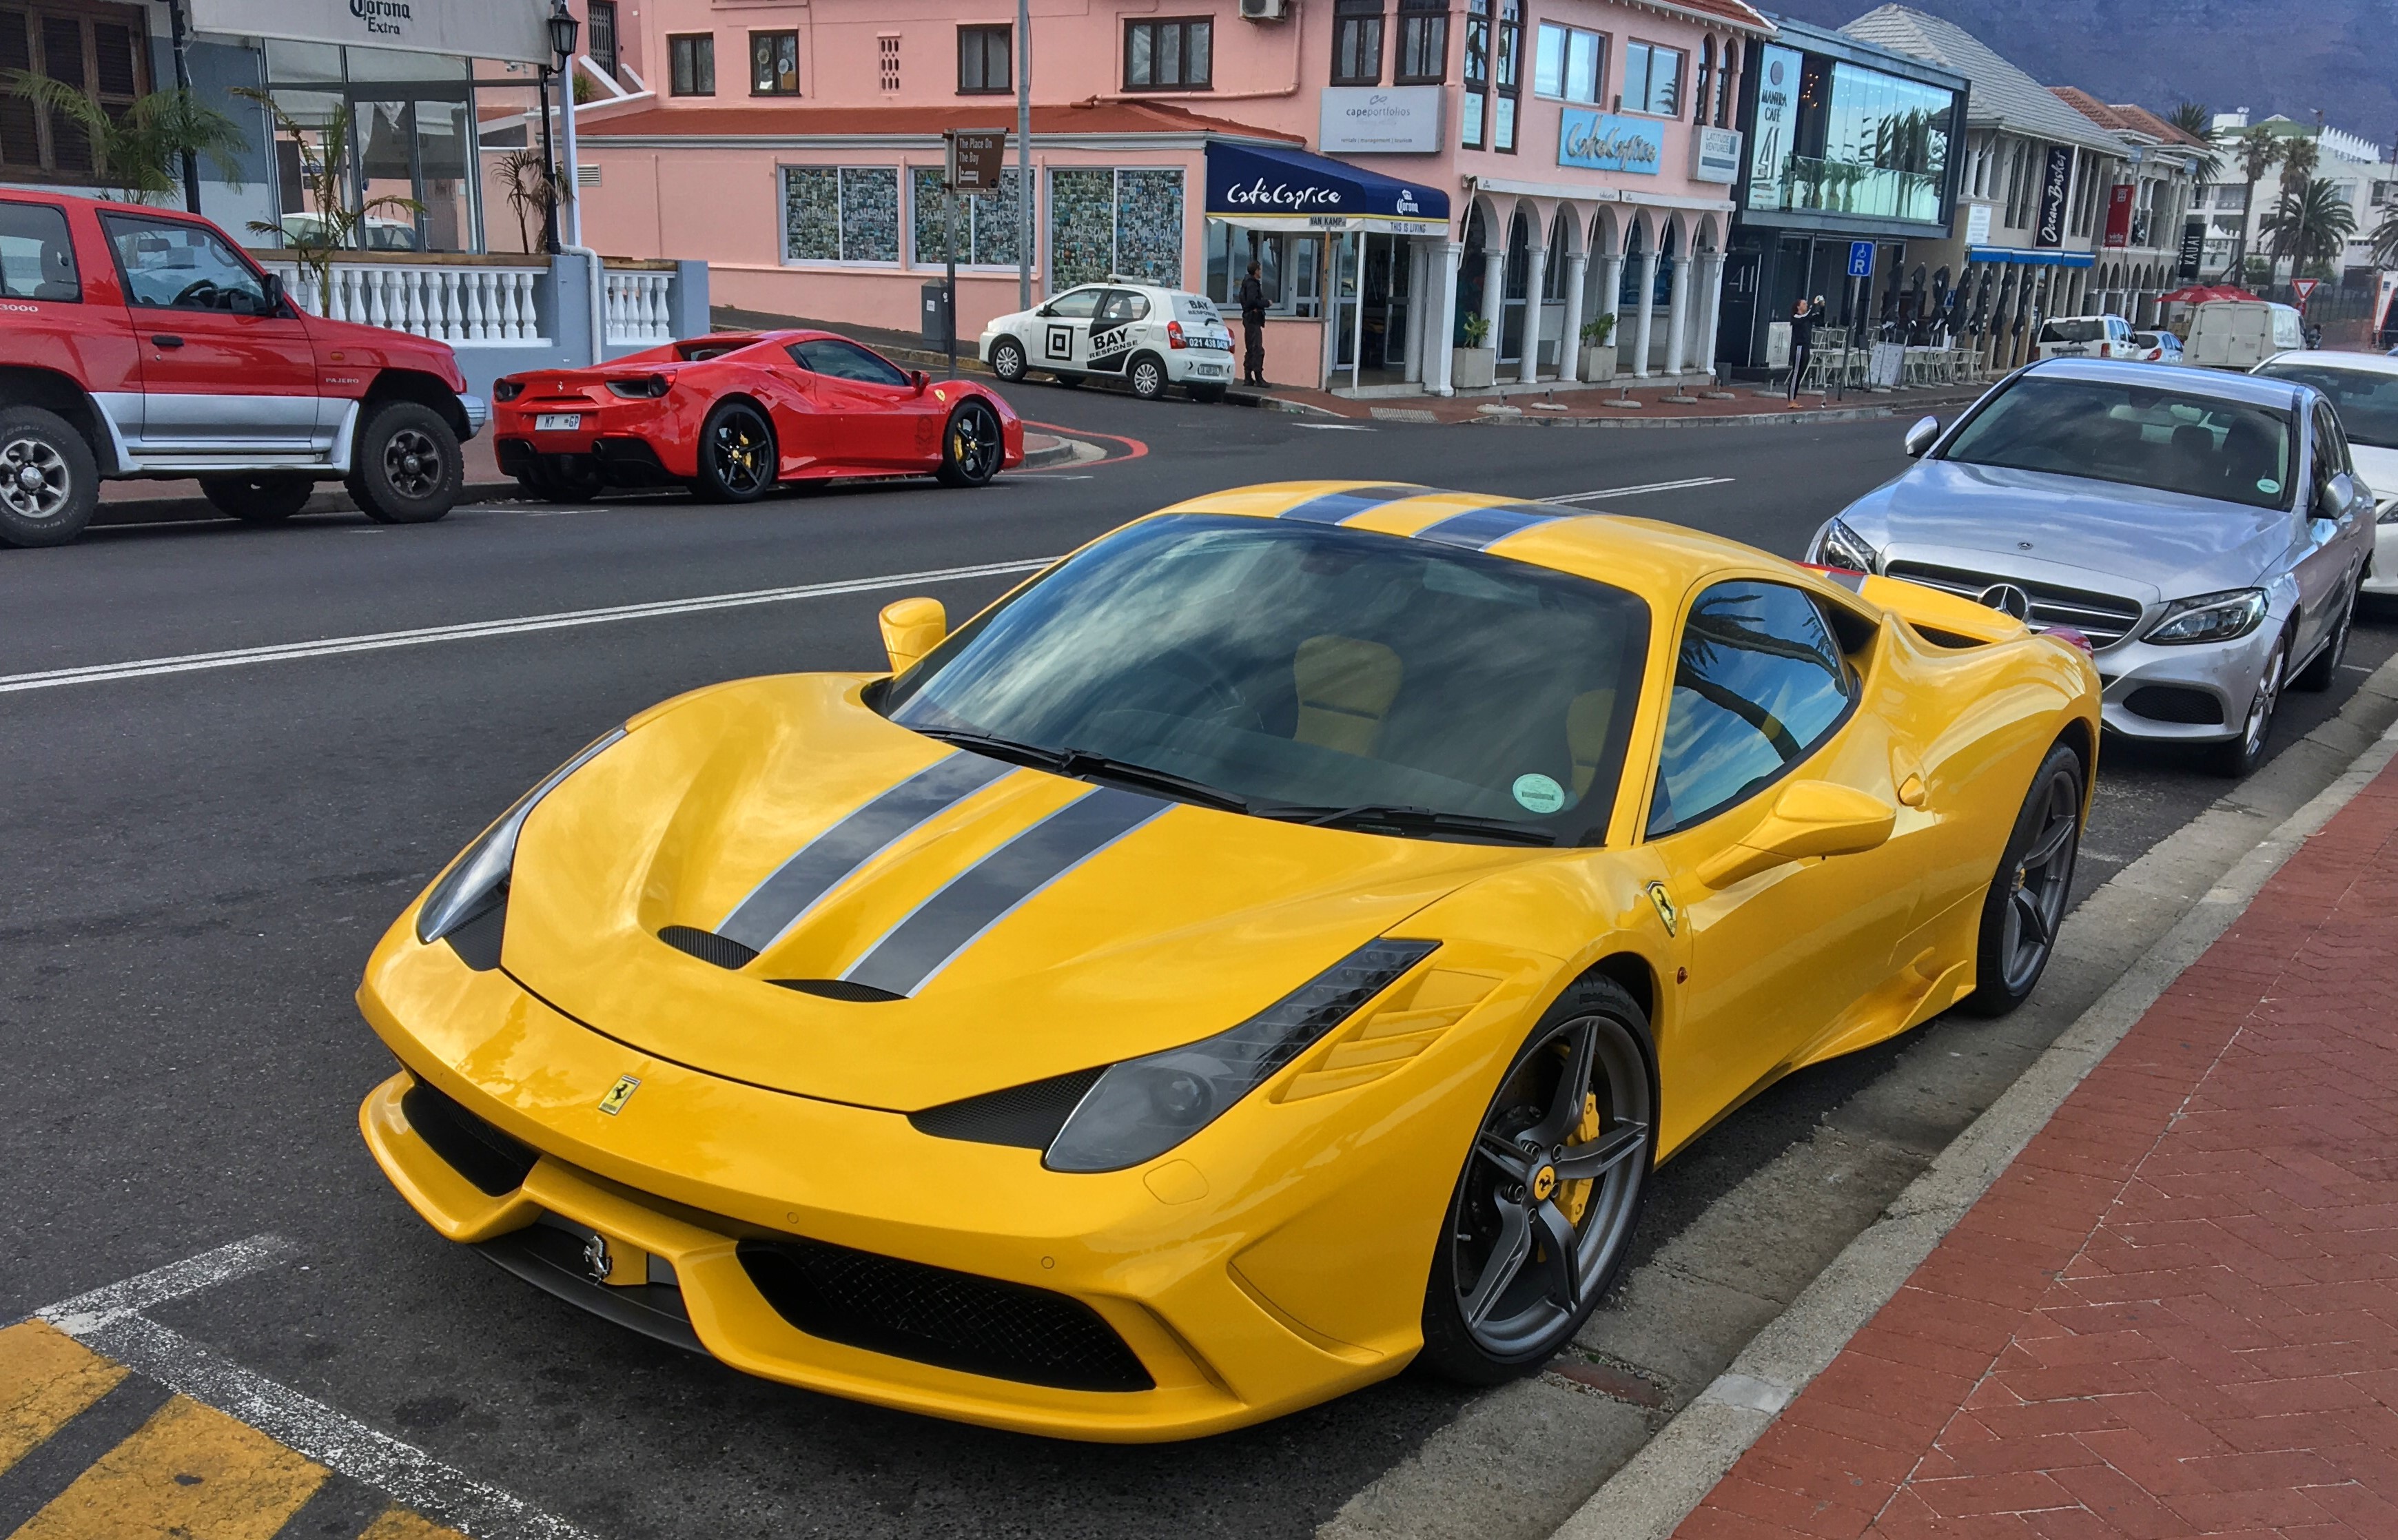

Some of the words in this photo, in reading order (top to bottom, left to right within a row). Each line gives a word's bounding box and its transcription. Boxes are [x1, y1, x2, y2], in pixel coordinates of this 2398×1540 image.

[349, 0, 411, 21] Corona
[368, 17, 400, 34] Extra
[959, 138, 969, 149] The
[970, 138, 984, 149] Place
[985, 138, 992, 149] On
[1705, 132, 1730, 144] LATITUDE
[959, 152, 968, 163] The
[969, 152, 979, 165] Bay
[1396, 198, 1420, 216] Corona
[1310, 216, 1322, 225] VAN
[1324, 216, 1342, 226] KAMP
[1390, 222, 1402, 232] THIS
[1403, 223, 1408, 232] IS
[2184, 236, 2200, 265] KAUAI
[1854, 259, 1865, 274] R
[1189, 300, 1208, 310] BAY
[1094, 327, 1128, 350] BAY
[1189, 338, 1202, 347] 021
[1089, 340, 1138, 358] RESPONSE
[569, 415, 579, 427] GP
